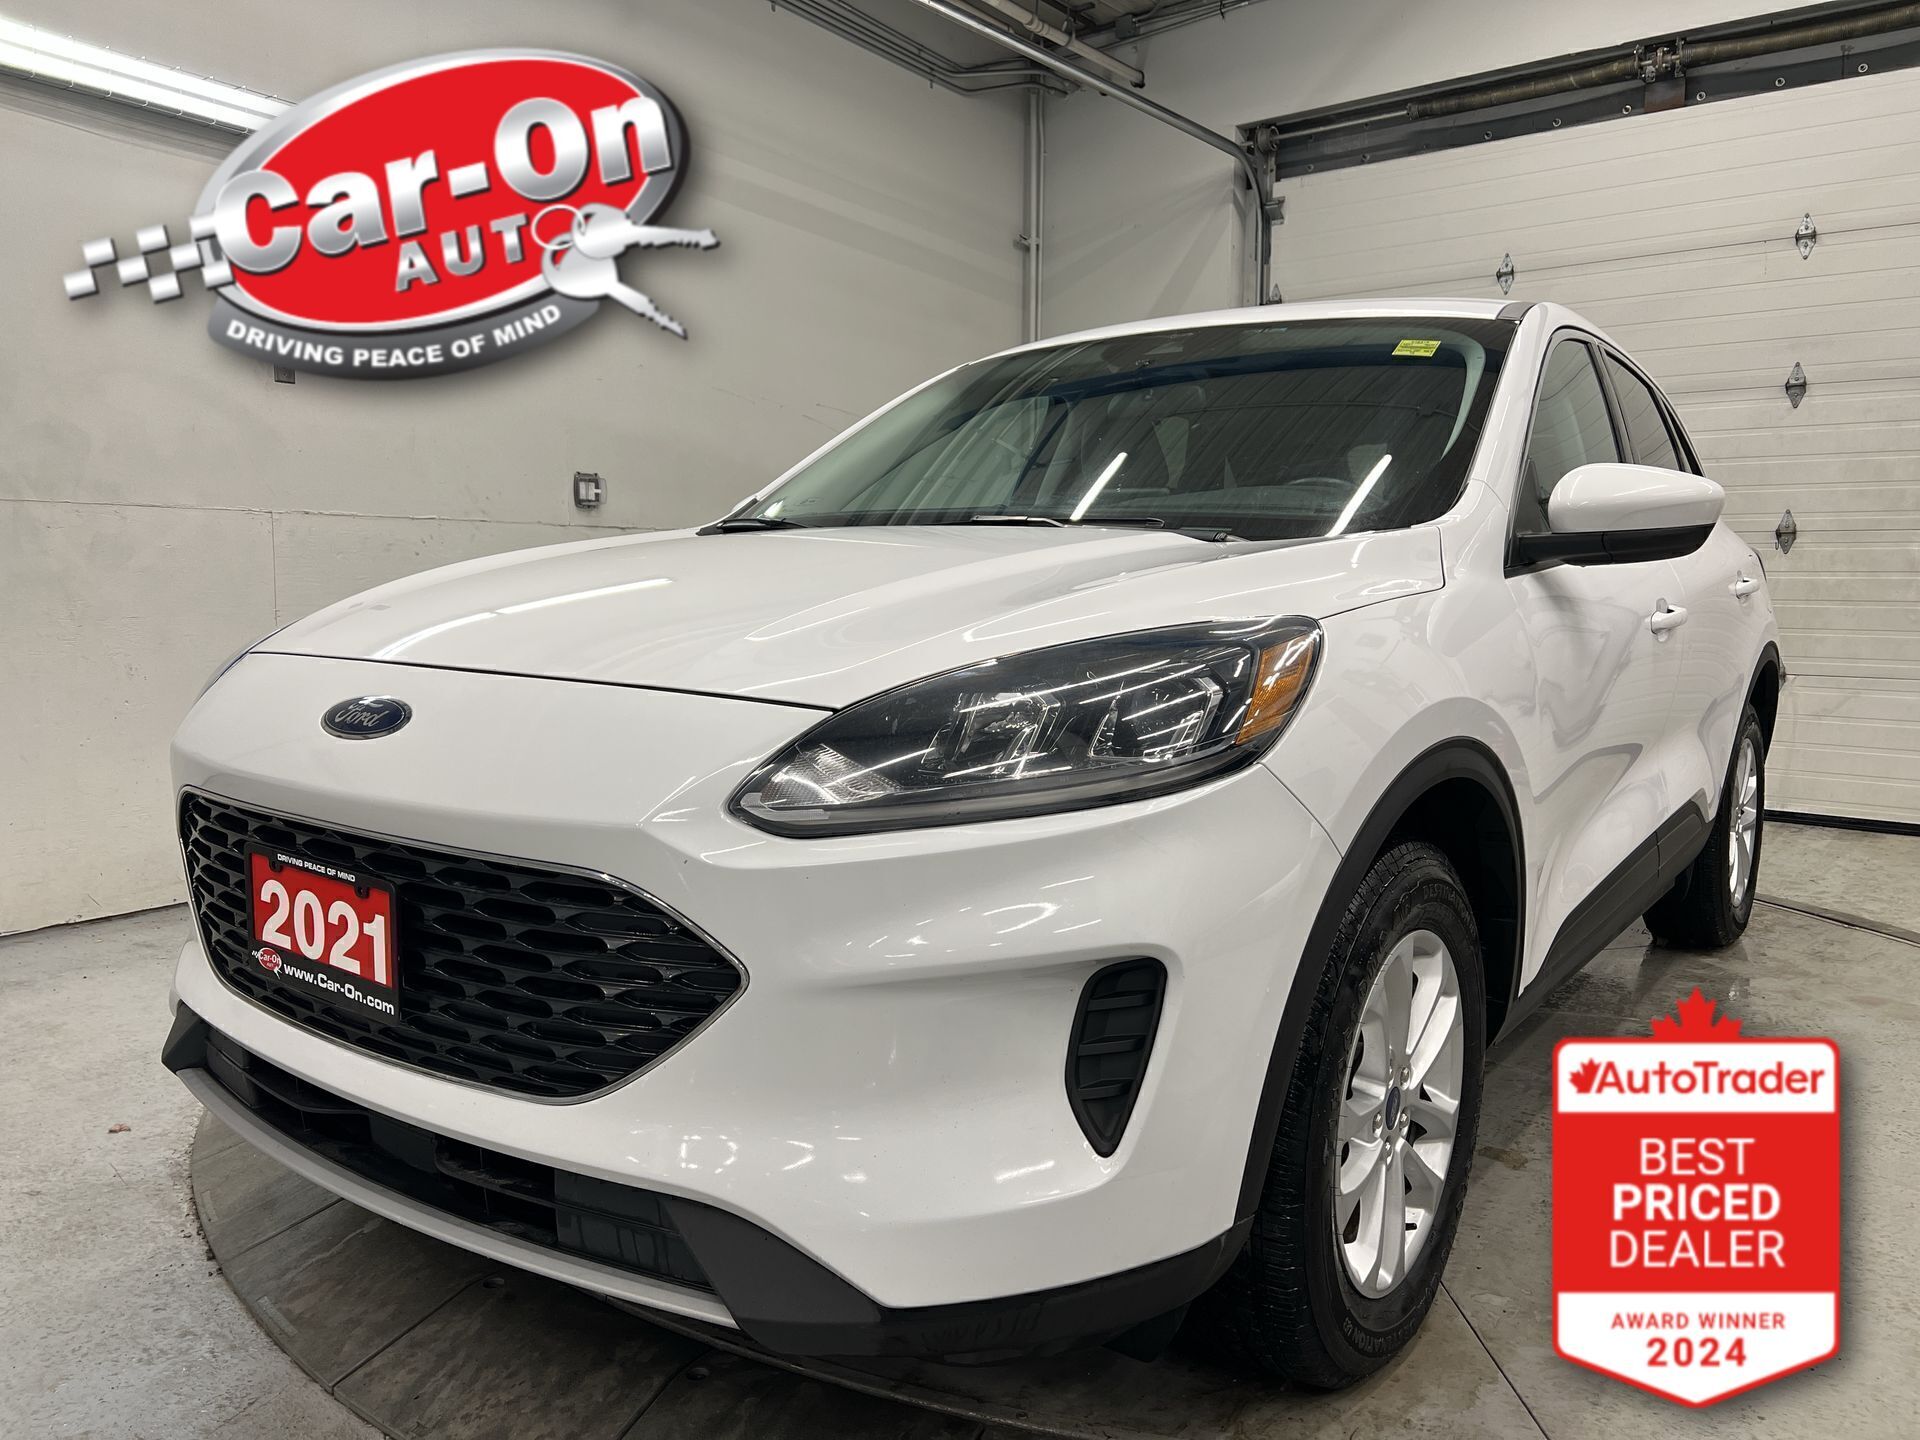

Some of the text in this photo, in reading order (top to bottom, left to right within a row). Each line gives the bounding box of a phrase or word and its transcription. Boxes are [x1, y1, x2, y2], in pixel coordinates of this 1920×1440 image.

[334, 702, 390, 727] Ford
[277, 853, 356, 882] DRIVING PEACE OF MIND
[260, 879, 387, 985] 2021
[283, 963, 395, 1015] www.Car-On.com
